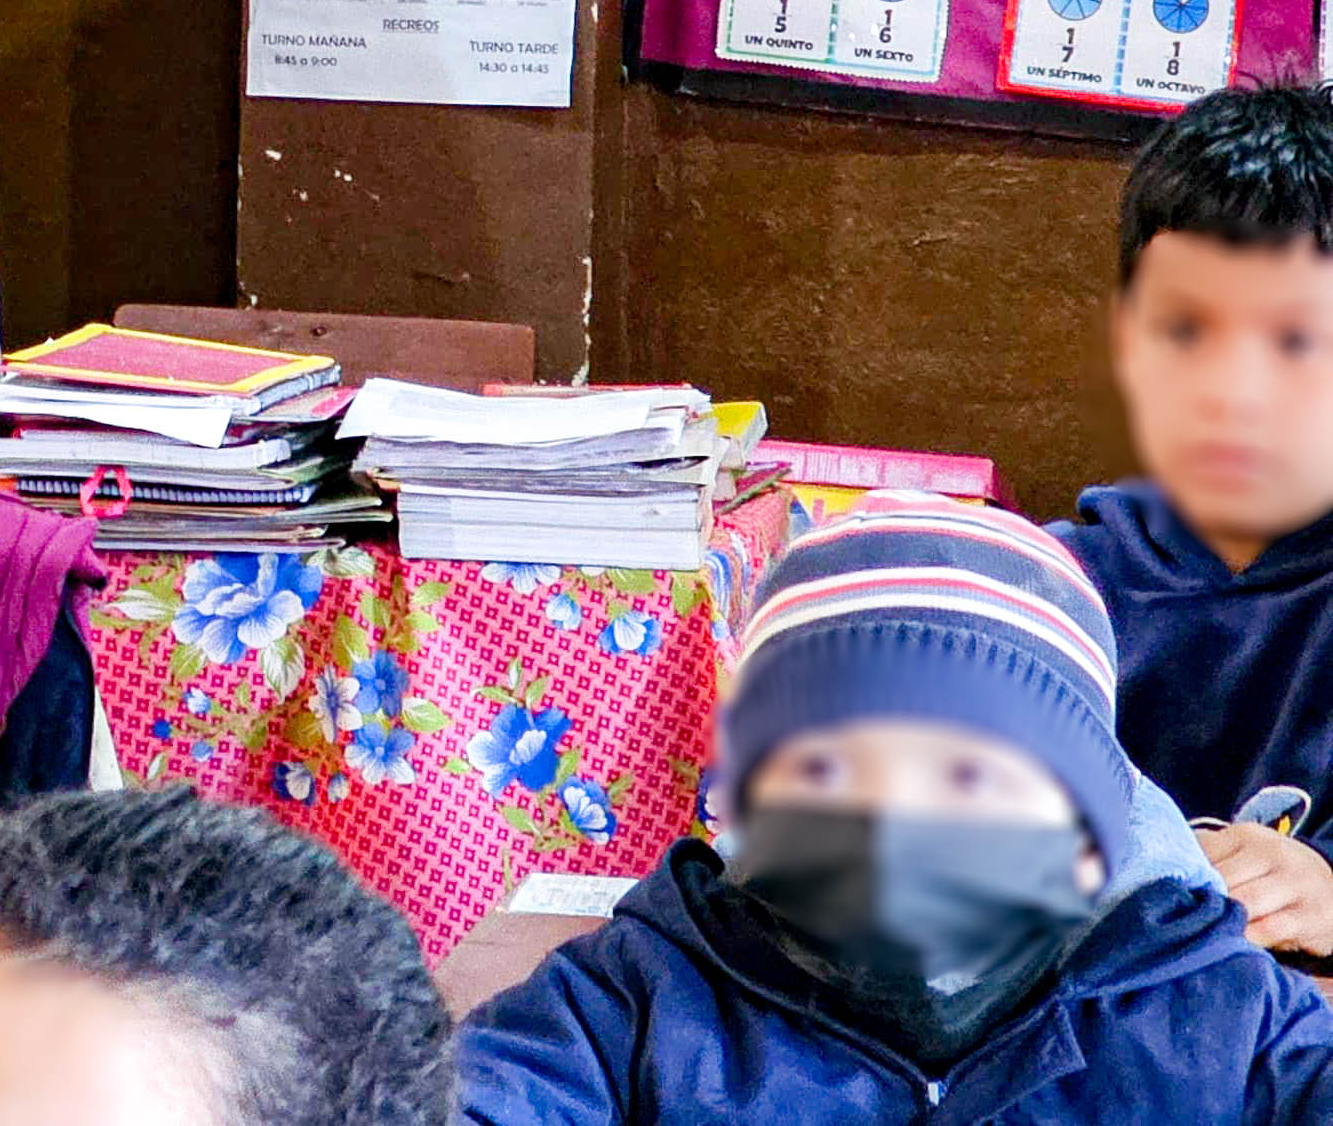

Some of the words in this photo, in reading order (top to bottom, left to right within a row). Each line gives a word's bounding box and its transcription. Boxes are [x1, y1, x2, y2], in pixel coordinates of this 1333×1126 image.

[884, 9, 893, 25] 1
[383, 19, 440, 31] RECREOS
[774, 17, 787, 33] 5
[261, 34, 306, 46] TURNO
[745, 35, 763, 46] UN
[766, 36, 813, 50] QUINTO
[880, 28, 891, 43] 6
[1066, 28, 1075, 44] 1
[469, 40, 514, 54] TURNO
[517, 42, 560, 55] TARDE
[855, 47, 873, 58] UN
[875, 49, 913, 62] SEXTO
[1062, 46, 1074, 63] 7
[1173, 41, 1181, 57] 1
[1027, 65, 1045, 76] UN
[1166, 59, 1180, 76] 8
[1136, 77, 1154, 88] UN
[1158, 81, 1206, 95] OCTAVO
